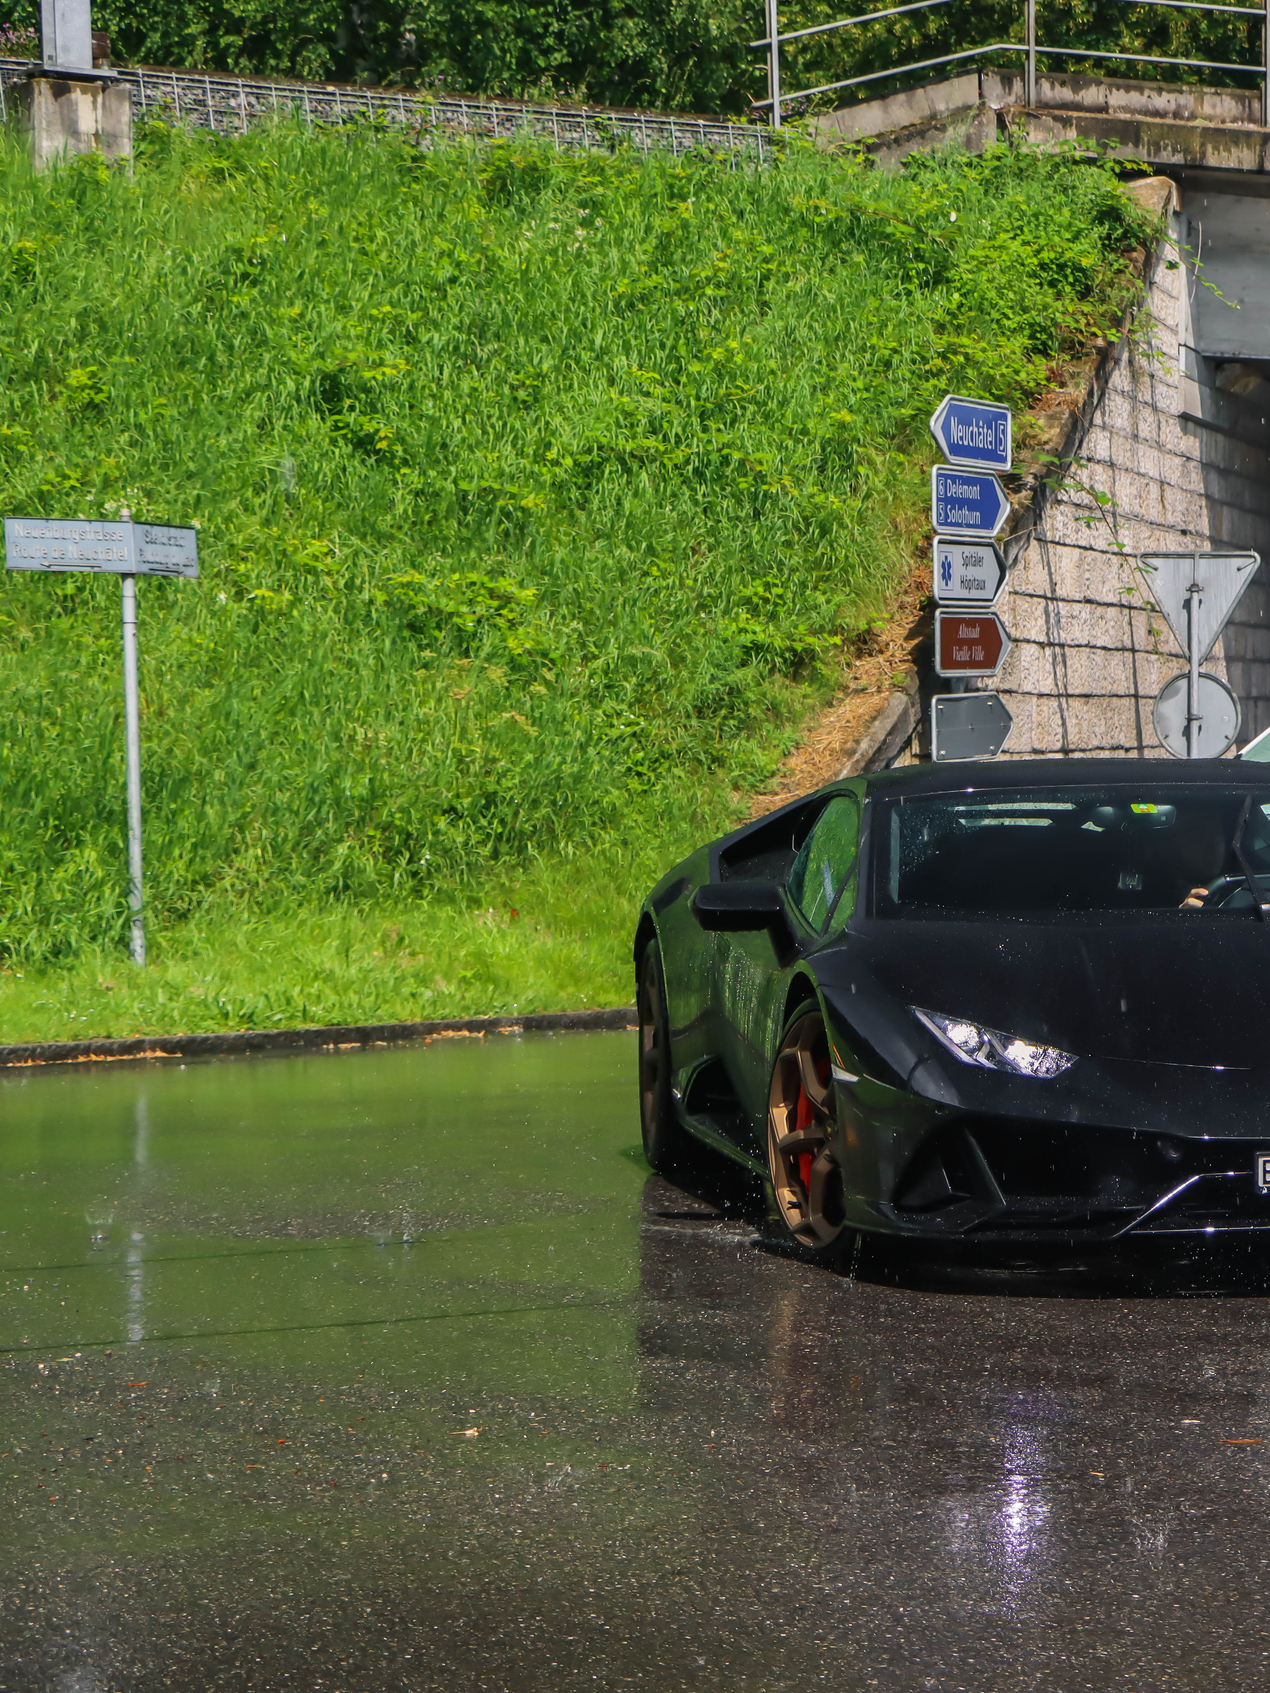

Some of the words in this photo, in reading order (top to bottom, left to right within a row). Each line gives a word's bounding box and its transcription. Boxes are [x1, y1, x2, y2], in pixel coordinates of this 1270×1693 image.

[951, 416, 995, 450] Neuchâtel
[999, 424, 1005, 451] 5
[939, 480, 944, 495] 6
[947, 479, 980, 500] Delémont
[939, 504, 944, 520] 5
[947, 504, 980, 525] Solothurn
[14, 522, 124, 544] Neuenburgstrasse
[12, 542, 48, 559] Route
[52, 544, 66, 559] de
[69, 544, 128, 561] Neuchâtel
[961, 551, 984, 570] Spitäler
[960, 575, 986, 594] Hôpitaux
[957, 623, 980, 639] Altstadt
[953, 646, 970, 661] Vieille
[972, 646, 985, 661] Ville
